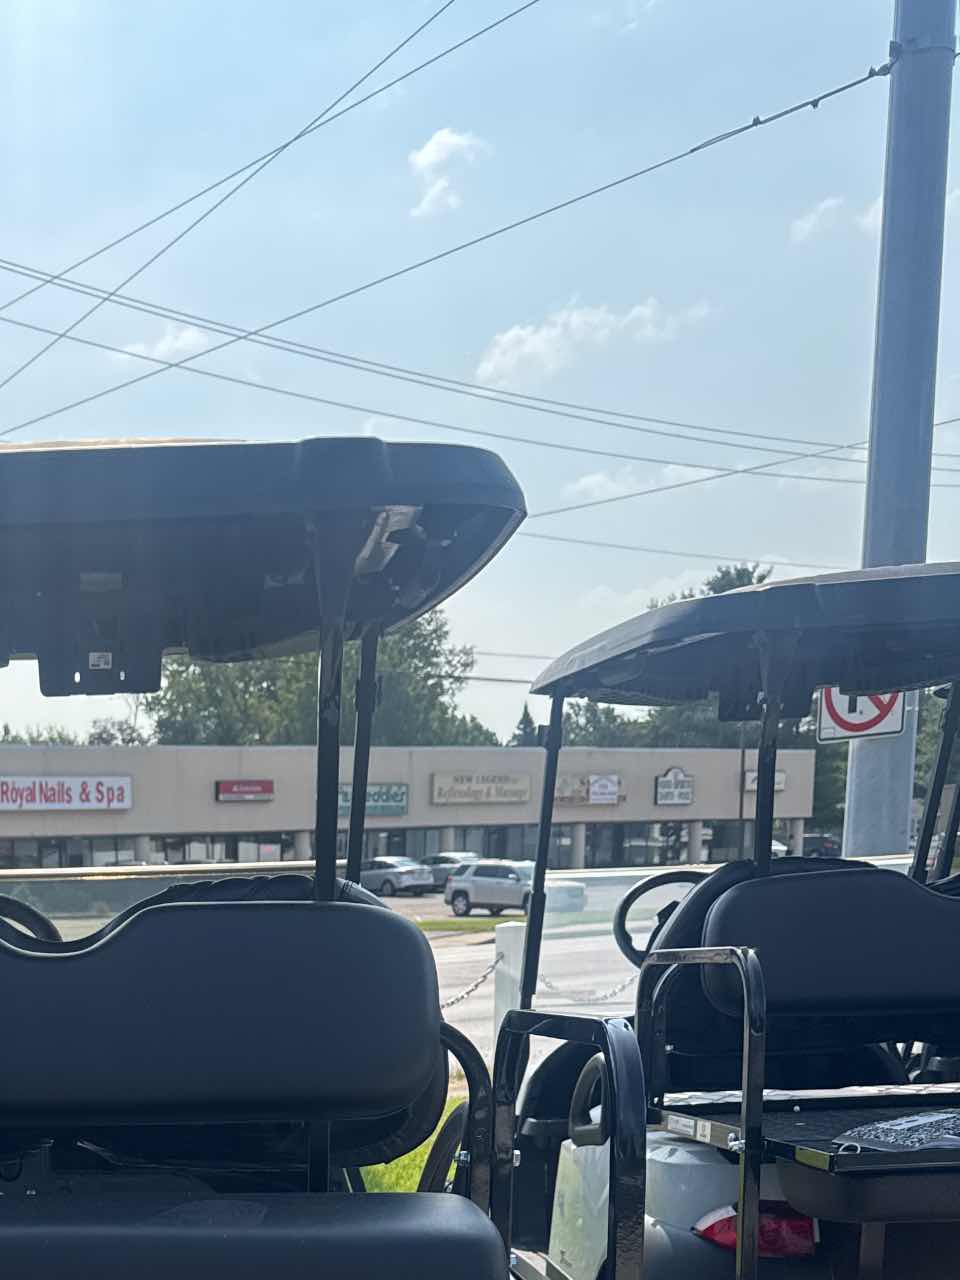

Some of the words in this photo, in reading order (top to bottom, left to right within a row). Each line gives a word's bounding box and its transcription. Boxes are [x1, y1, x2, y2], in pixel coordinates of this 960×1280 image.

[0, 781, 36, 808] Royal
[39, 780, 73, 804] Nails
[79, 780, 91, 803] &
[95, 781, 126, 808] Spa
